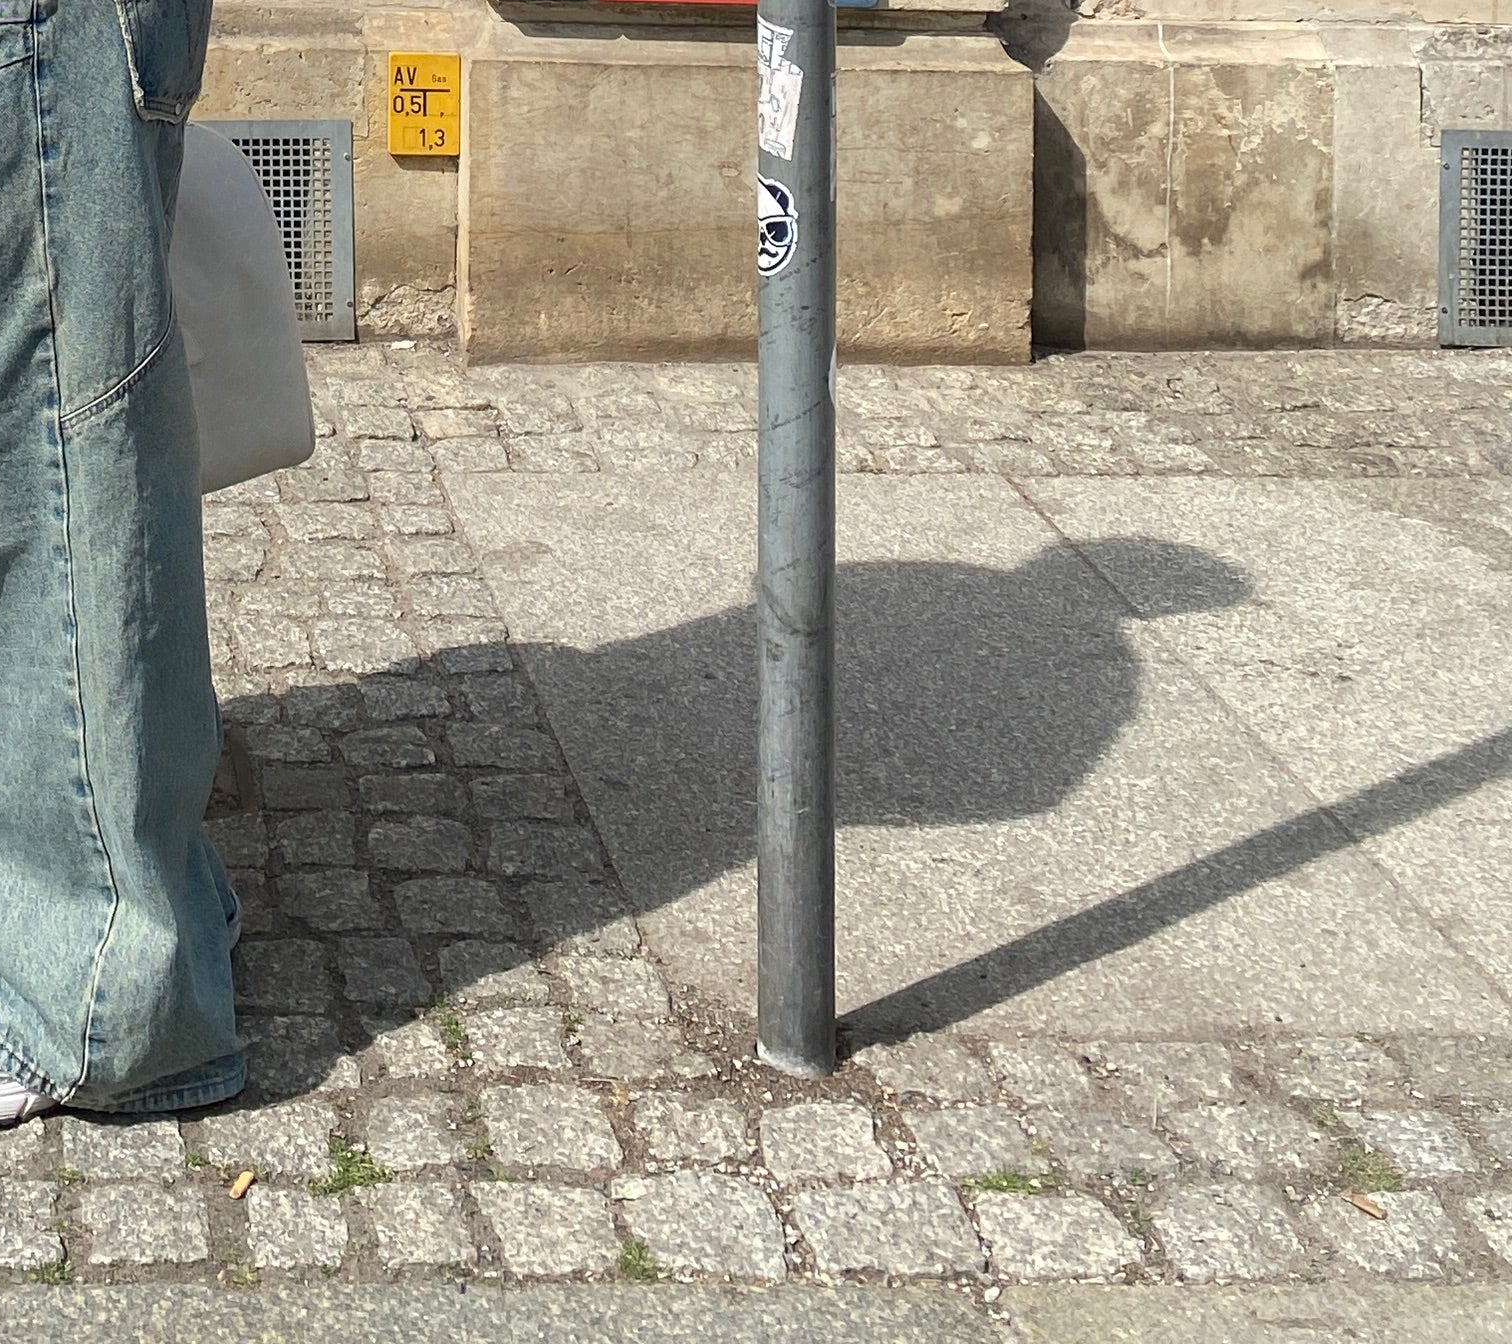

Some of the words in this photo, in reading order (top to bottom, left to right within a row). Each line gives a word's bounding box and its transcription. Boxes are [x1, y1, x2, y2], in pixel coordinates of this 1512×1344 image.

[394, 66, 417, 86] AV
[393, 95, 422, 117] 0,5
[419, 128, 445, 151] 1,3
